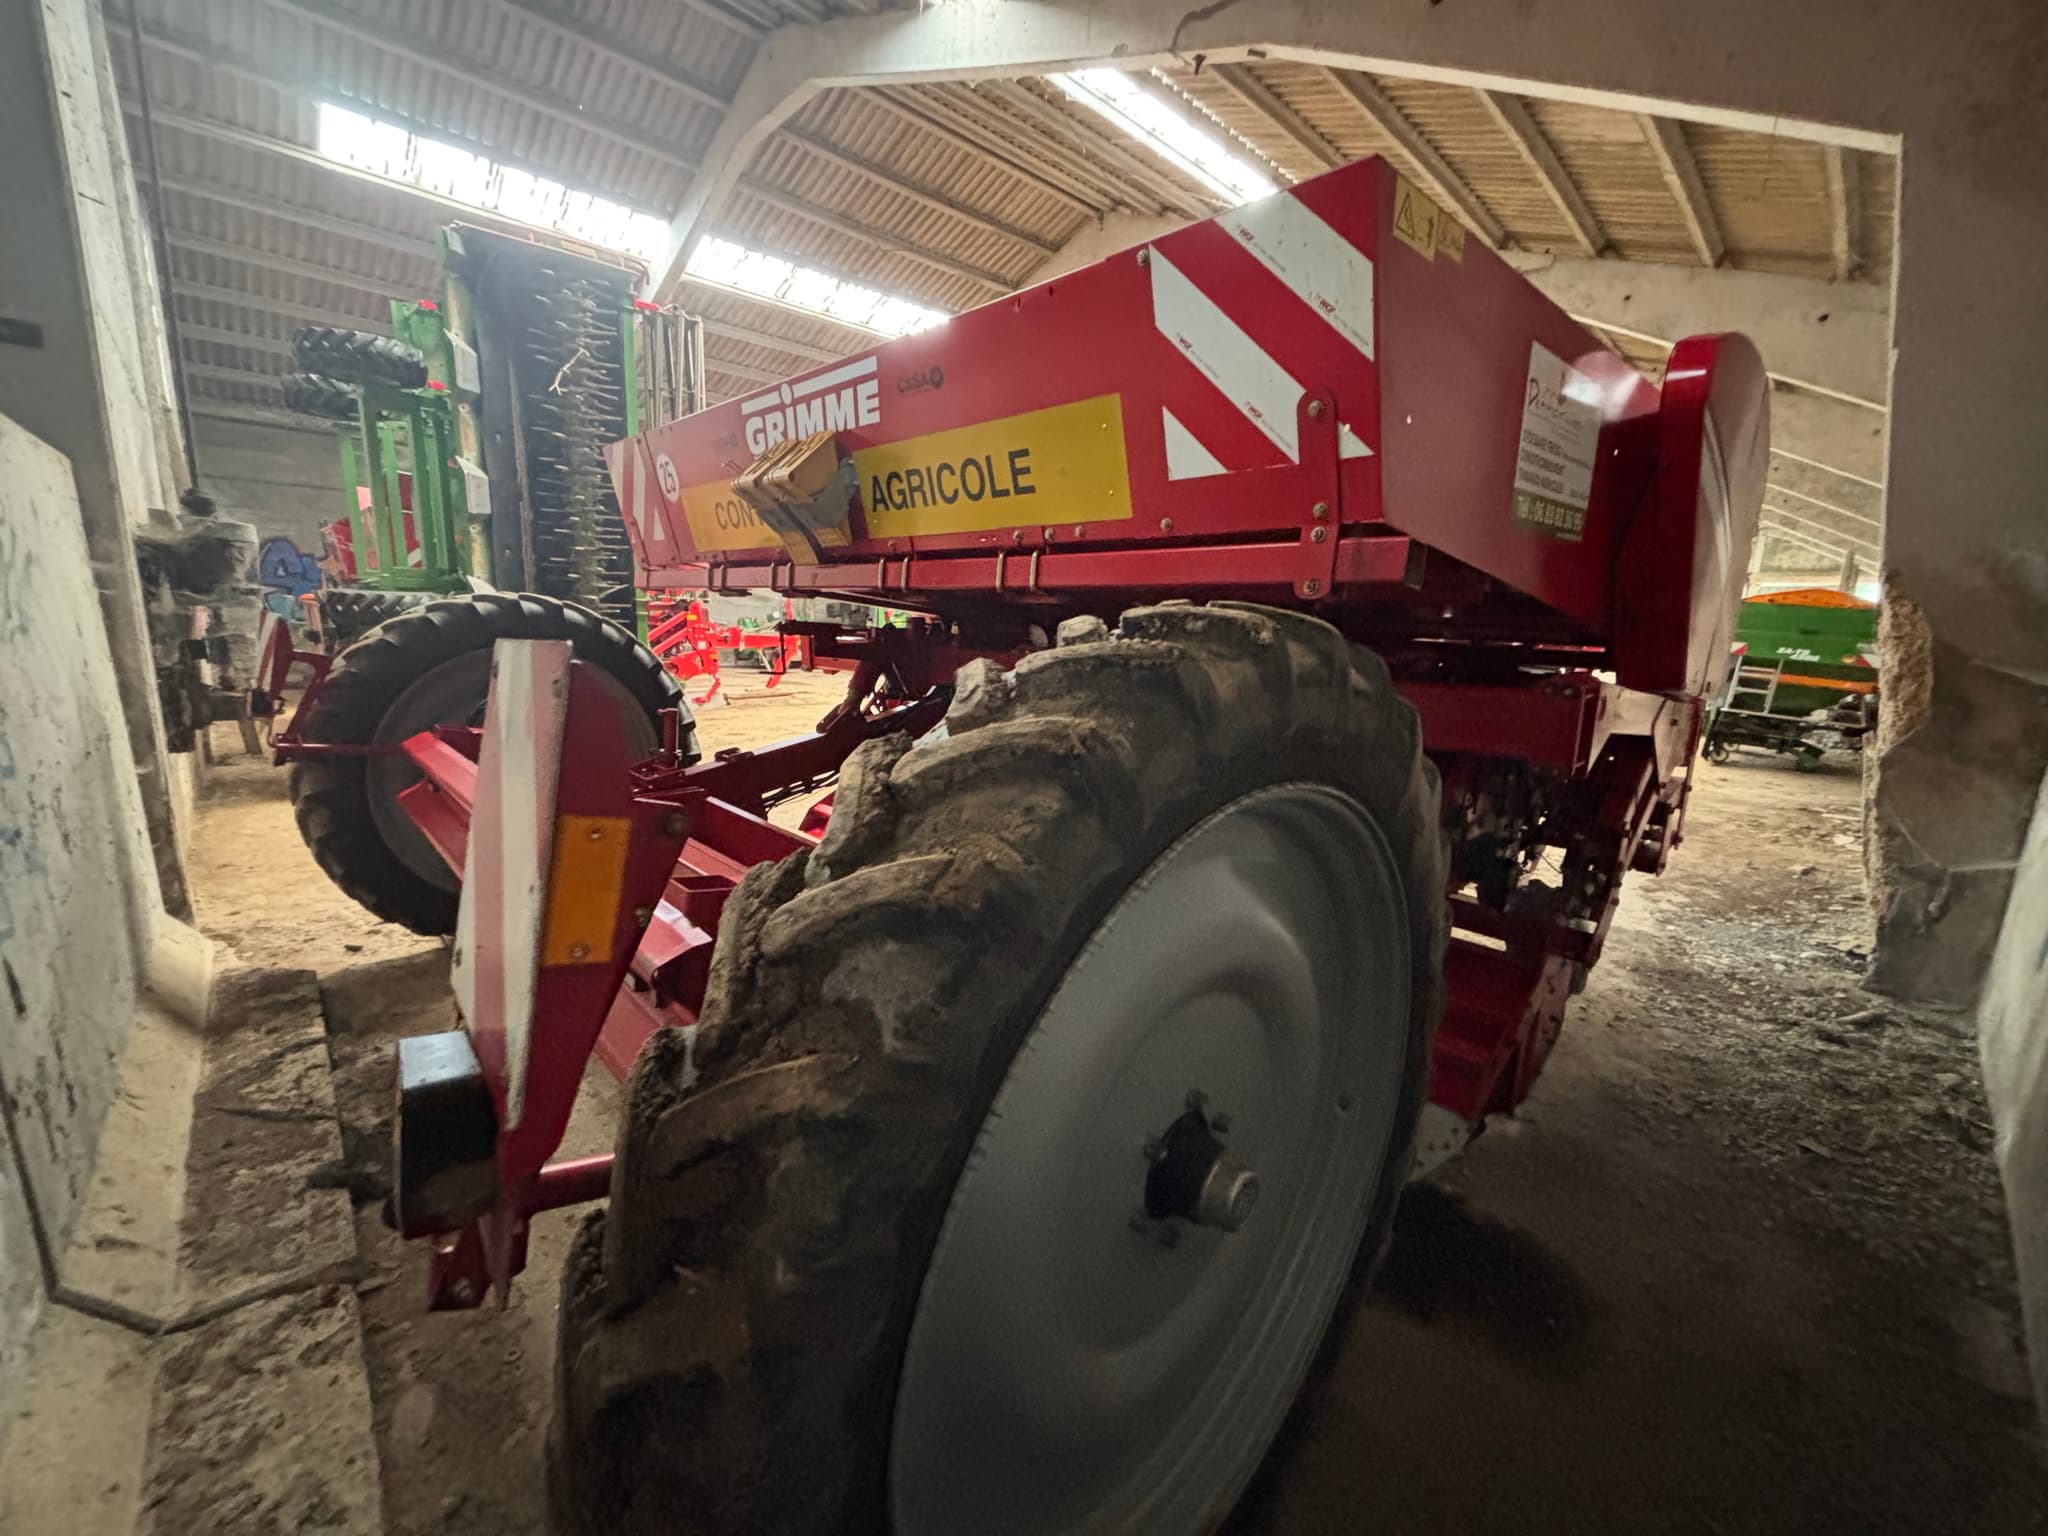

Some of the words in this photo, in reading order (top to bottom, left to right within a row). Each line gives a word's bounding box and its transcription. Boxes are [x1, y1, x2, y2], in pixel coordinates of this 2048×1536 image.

[745, 379, 880, 457] GRIMME
[659, 460, 678, 494] 25
[715, 499, 764, 530] CON
[872, 448, 1036, 513] AGRICOLE
